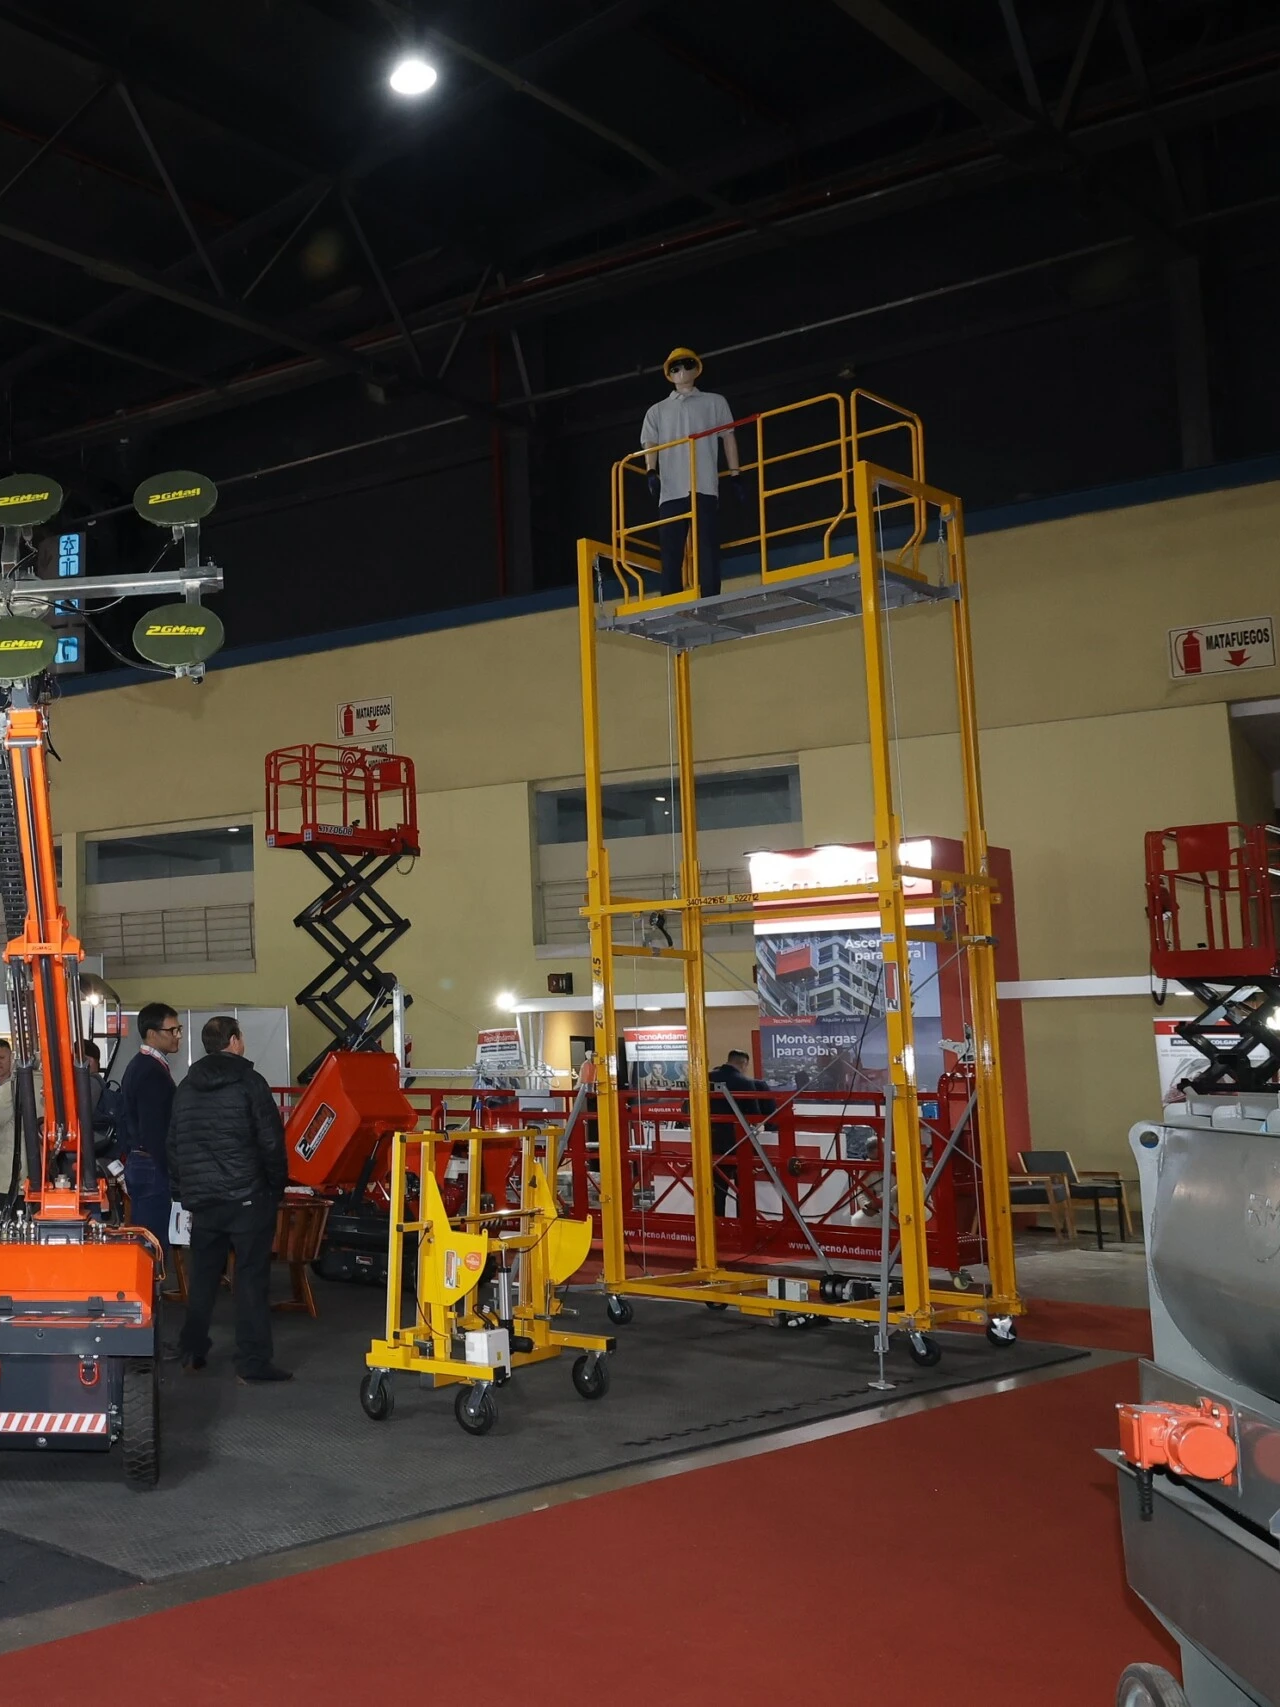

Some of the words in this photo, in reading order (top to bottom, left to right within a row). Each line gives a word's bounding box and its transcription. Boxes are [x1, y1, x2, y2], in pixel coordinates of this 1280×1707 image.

[148, 487, 201, 505] 2GMaq
[145, 625, 207, 636] 2GMaq
[1205, 628, 1270, 650] MATAFUEGOS
[356, 704, 391, 719] MATAFUEGOS
[854, 950, 884, 963] para
[592, 957, 602, 977] 4.5
[634, 1033, 687, 1041] TecnoAndami
[775, 1034, 857, 1047] Montacargas
[776, 1046, 804, 1059] para
[806, 1045, 838, 1057] Obra
